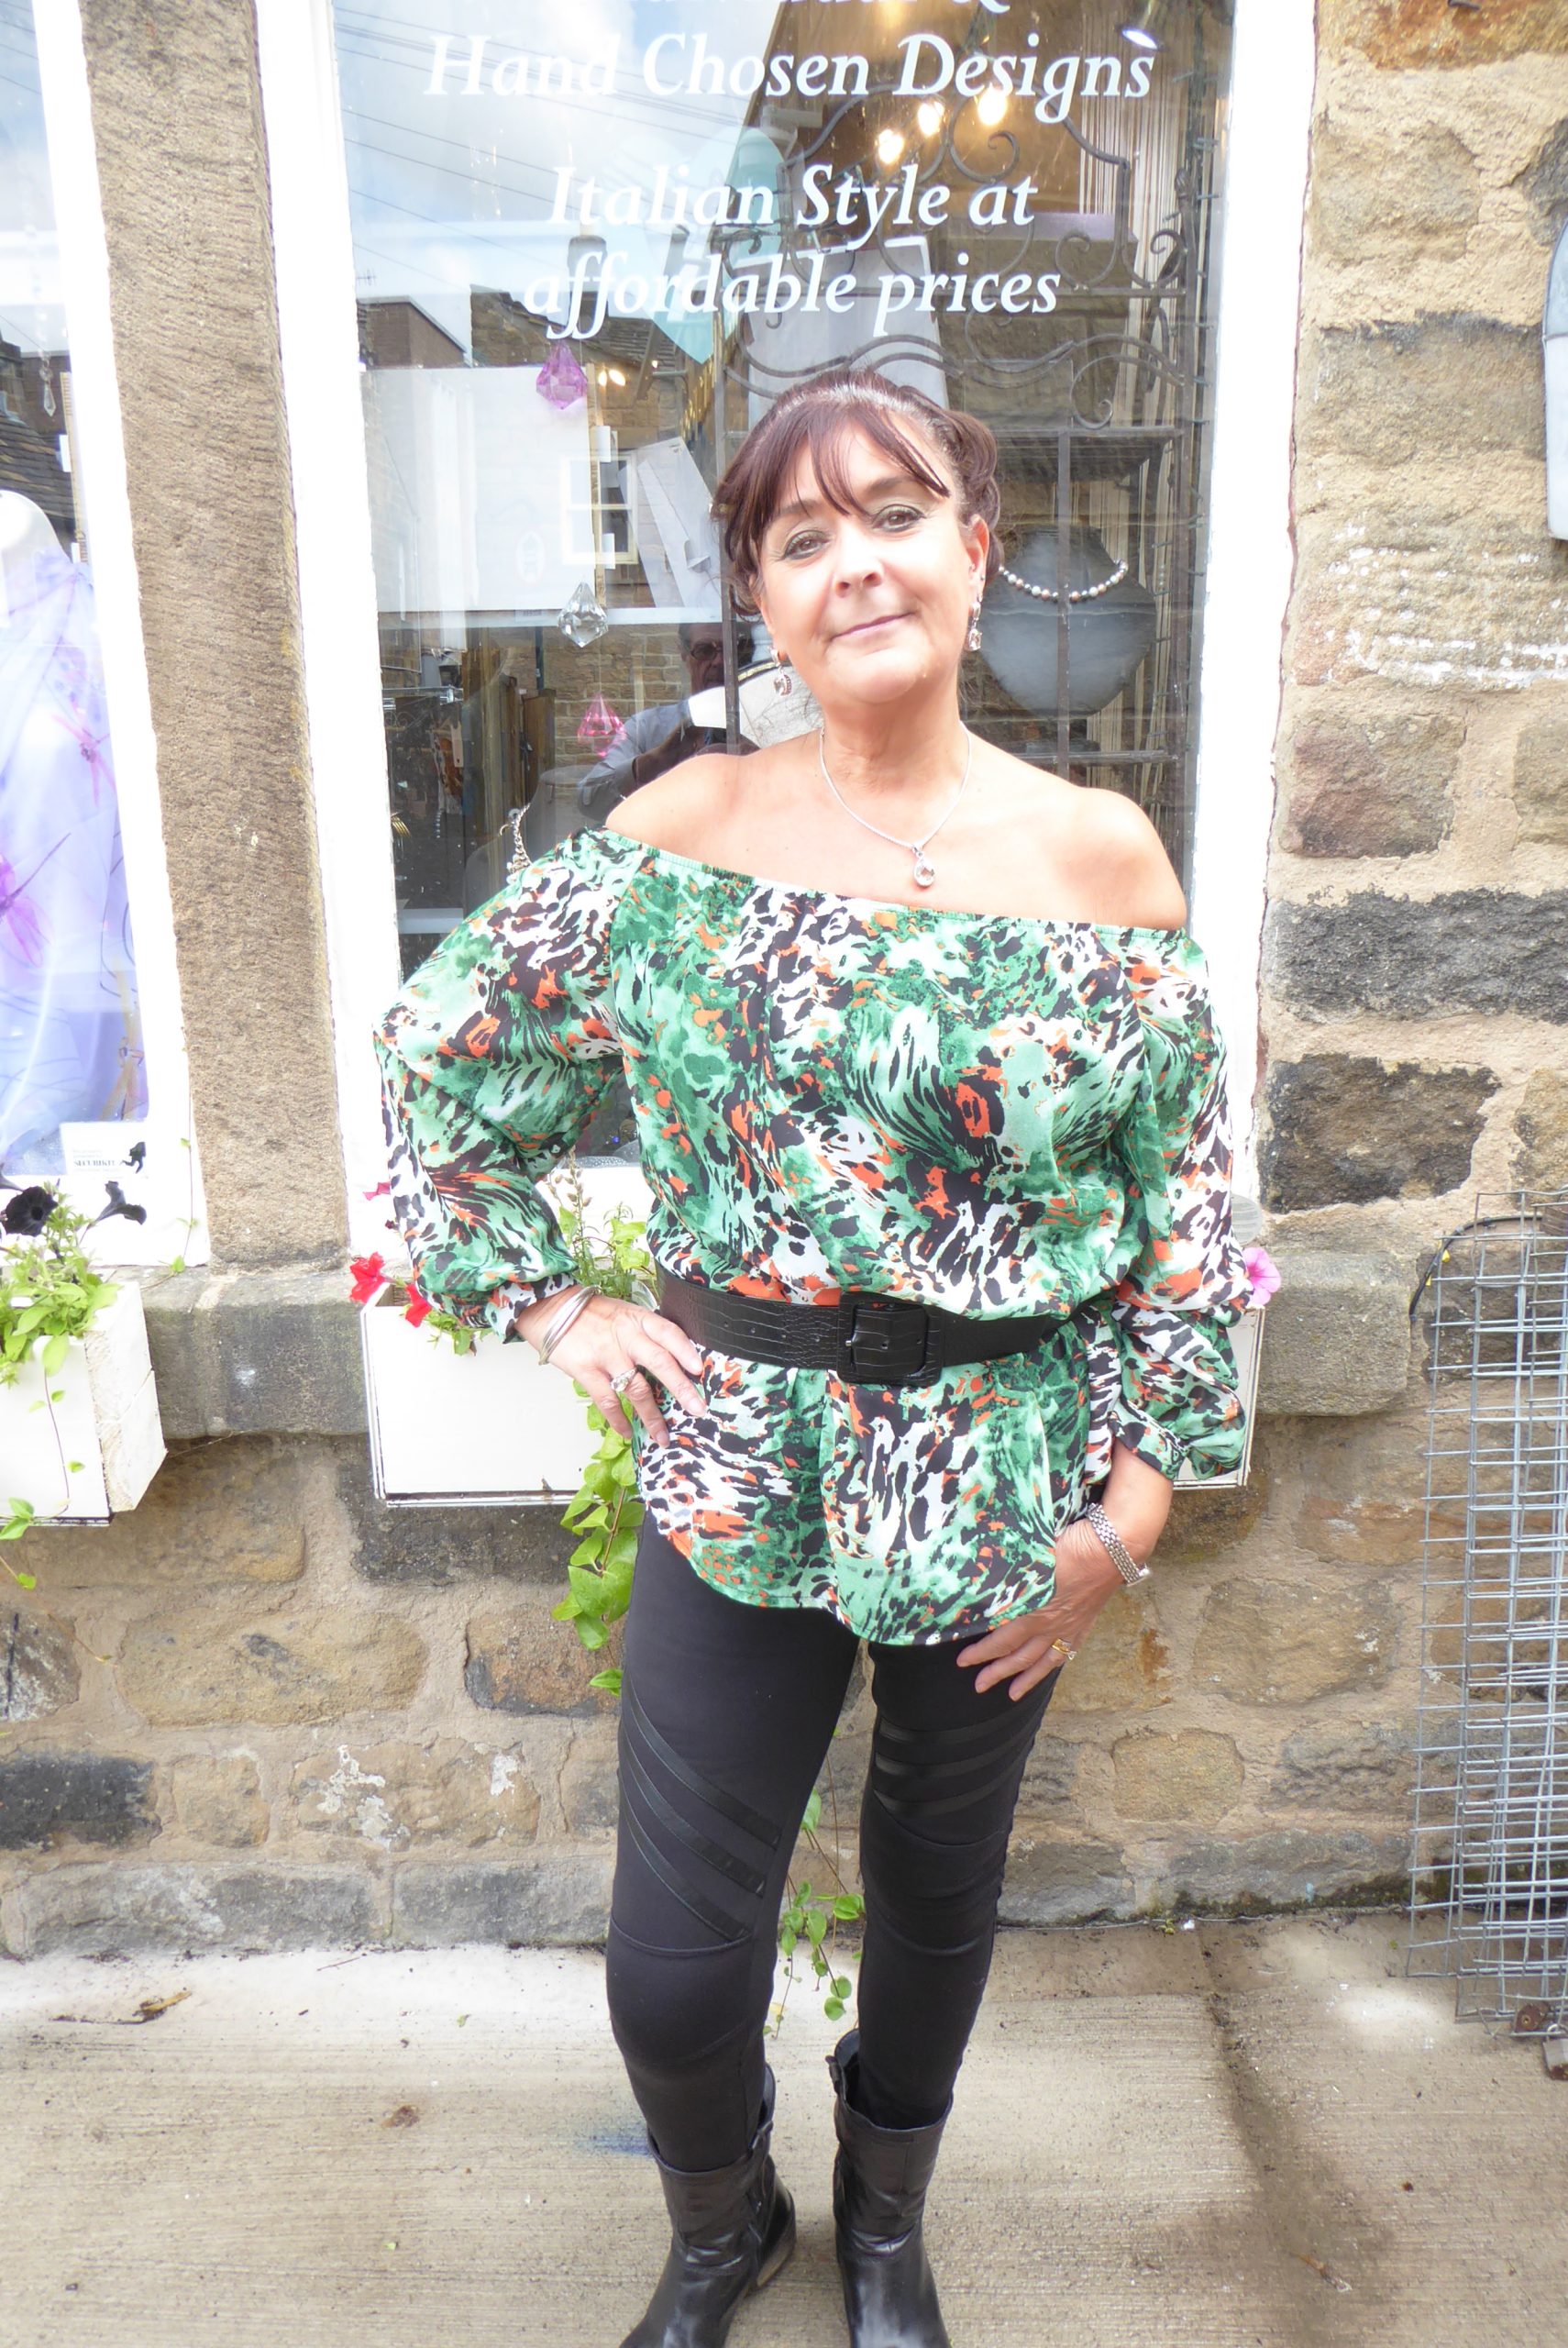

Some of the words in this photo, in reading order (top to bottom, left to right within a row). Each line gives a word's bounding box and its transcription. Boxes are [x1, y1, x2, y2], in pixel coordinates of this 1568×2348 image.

[423, 33, 622, 95] Hand
[643, 33, 869, 96] Chosen
[892, 33, 1154, 124] Designs
[547, 165, 774, 226] Italian
[797, 163, 950, 250] Style
[968, 176, 1038, 226] at
[524, 250, 856, 339] affordable
[872, 251, 1060, 337] prices
